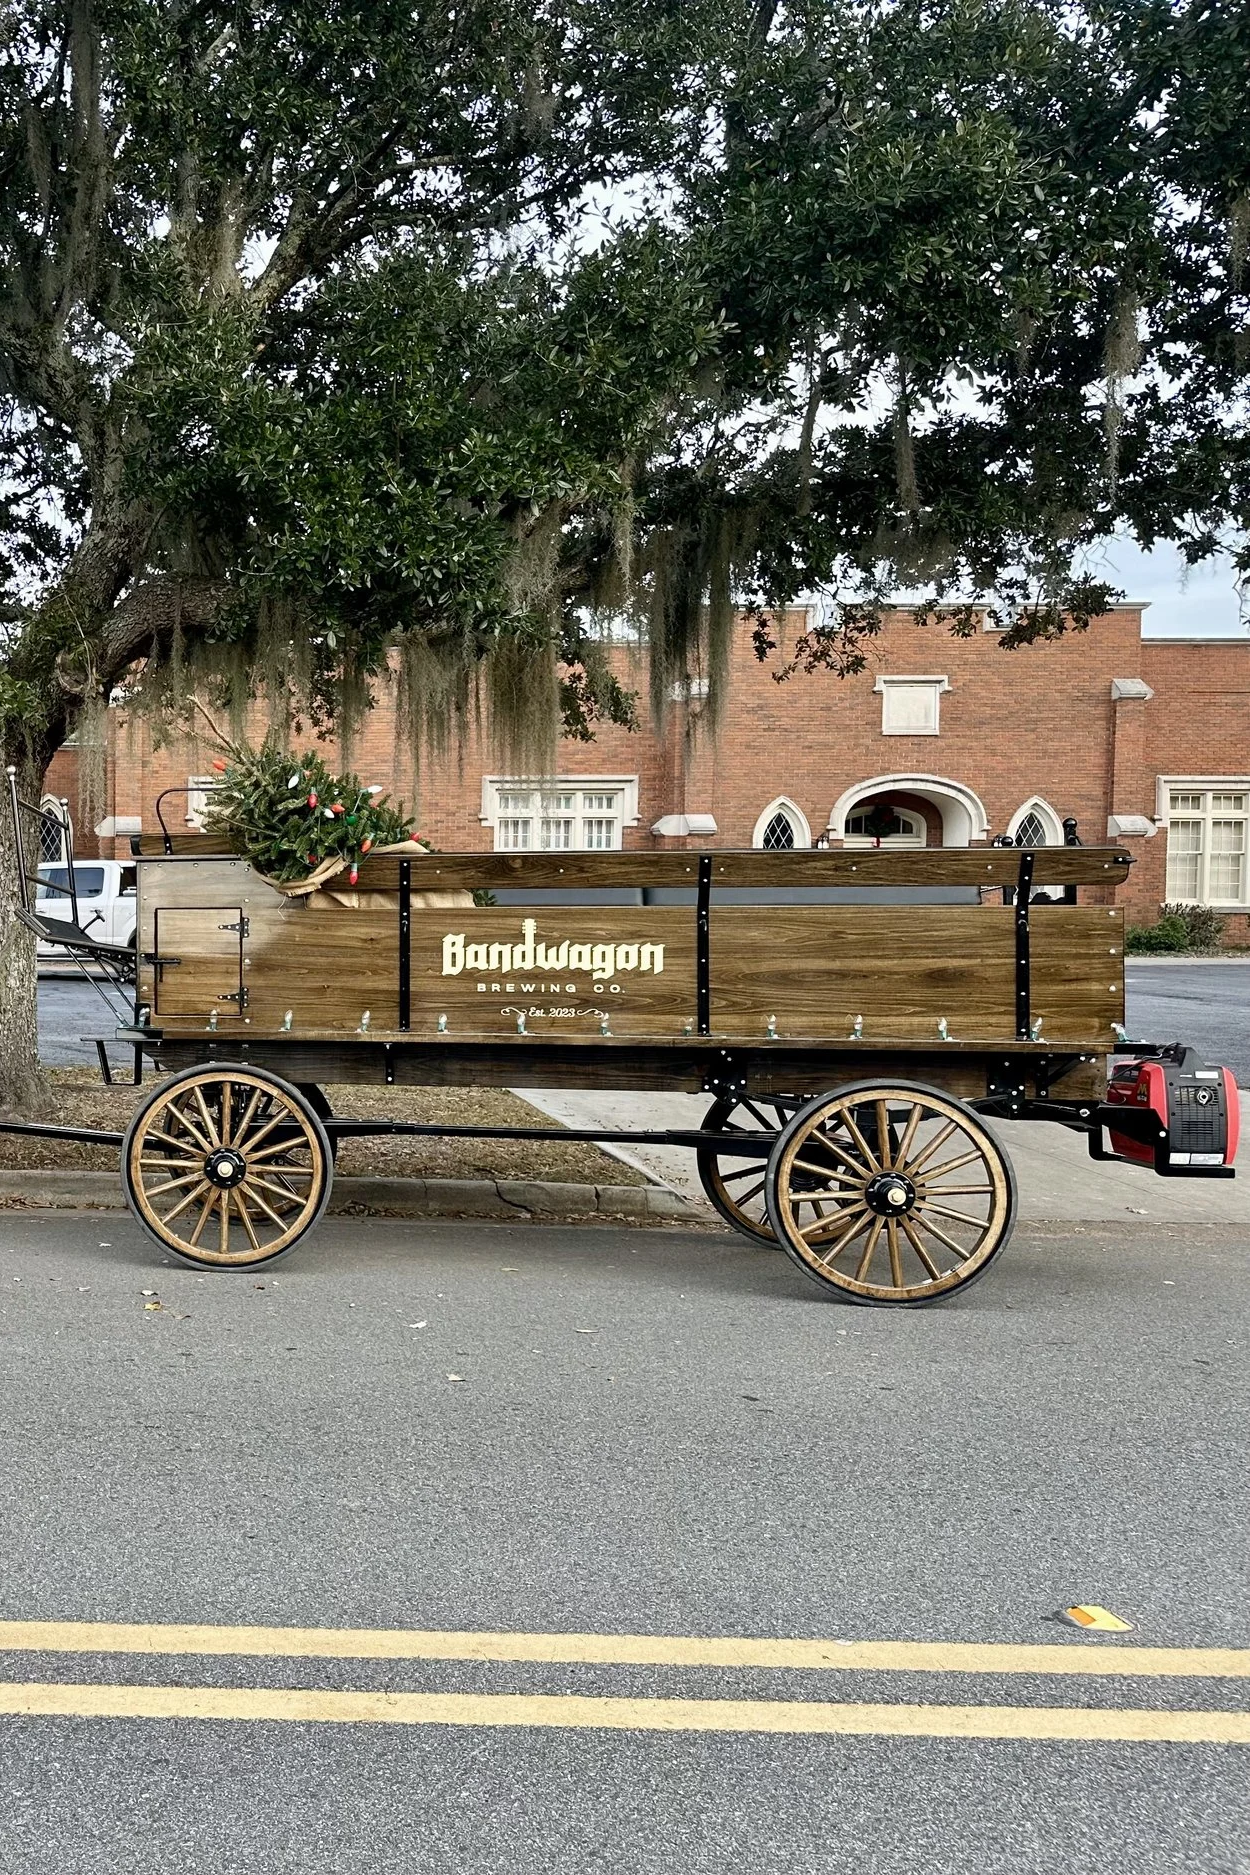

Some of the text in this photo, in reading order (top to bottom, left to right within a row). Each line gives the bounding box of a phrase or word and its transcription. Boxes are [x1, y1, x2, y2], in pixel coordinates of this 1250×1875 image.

[441, 918, 666, 980] Bandwagon
[476, 983, 626, 993] BREWING CO.
[528, 1006, 576, 1018] Est. 2023
